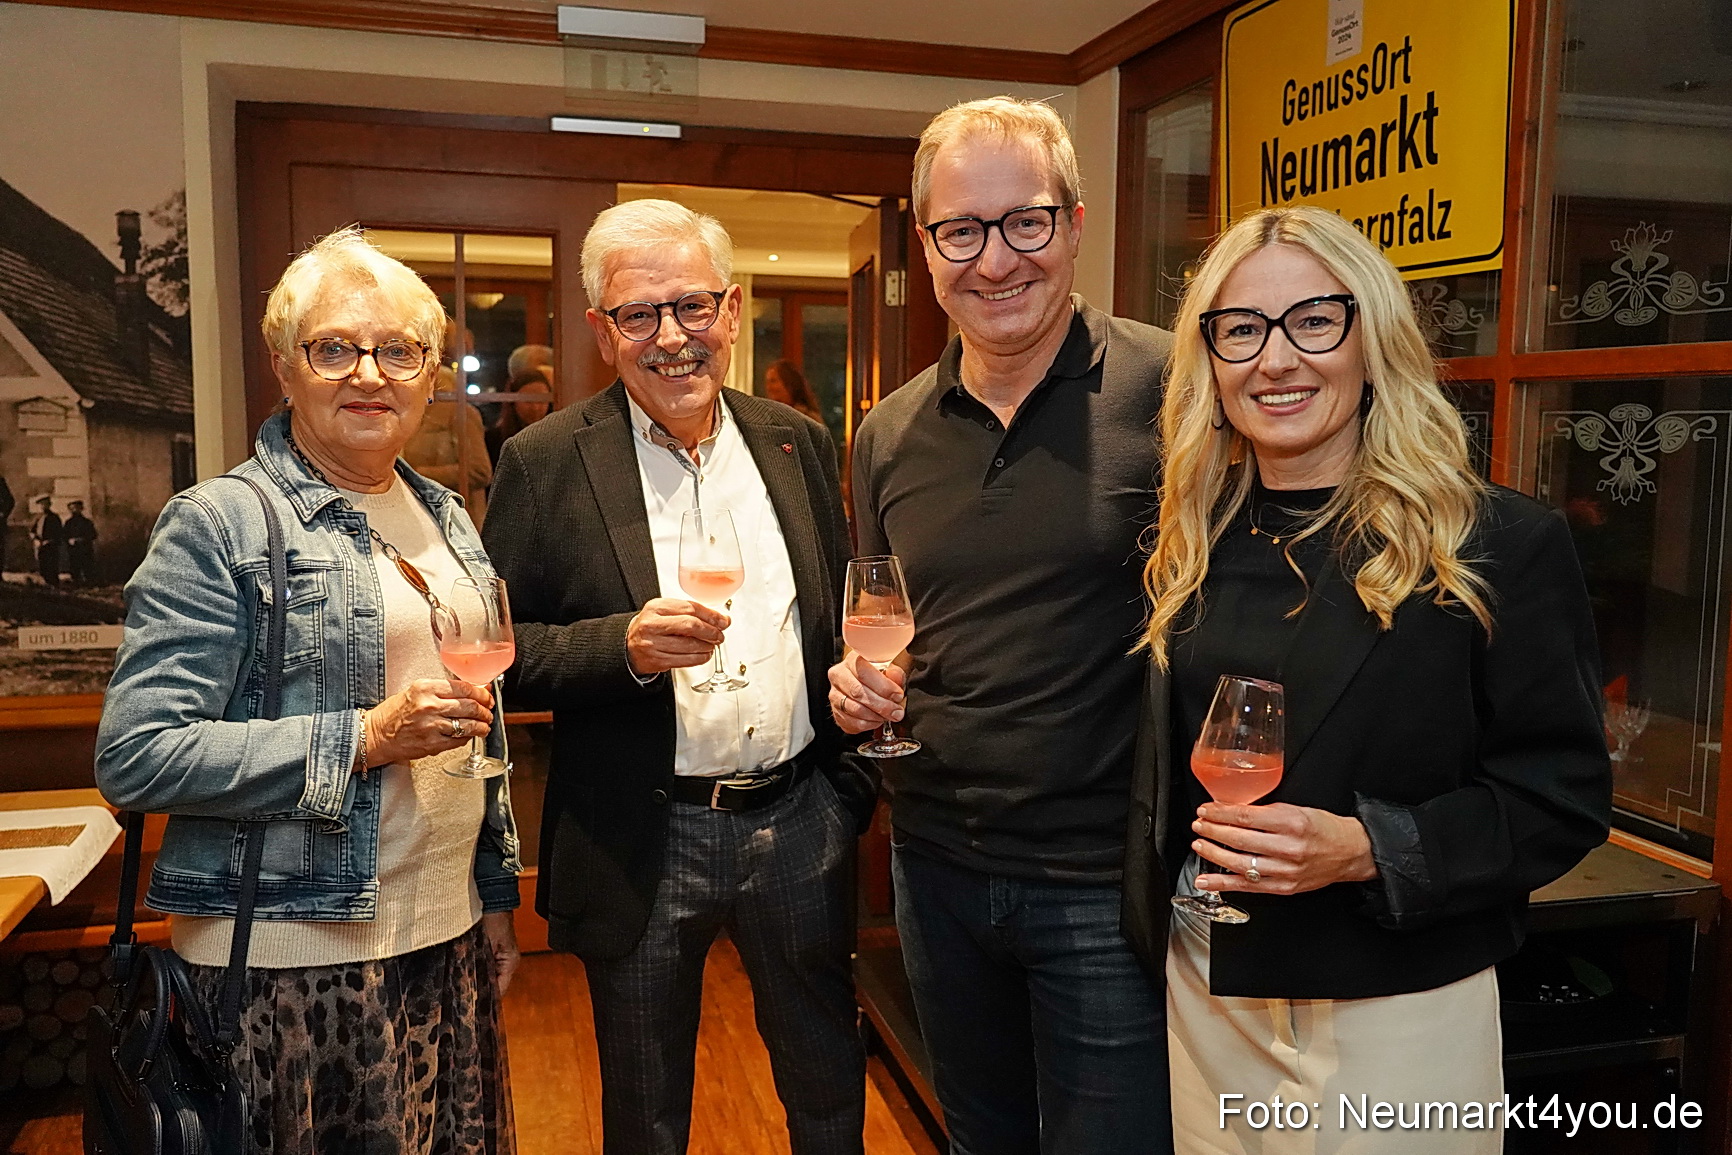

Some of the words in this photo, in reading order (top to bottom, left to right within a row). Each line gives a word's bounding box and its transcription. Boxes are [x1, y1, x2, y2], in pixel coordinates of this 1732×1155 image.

[1282, 35, 1413, 127] GenussOrt
[1261, 90, 1439, 208] Neumarkt
[29, 633, 54, 645] um
[60, 630, 98, 644] 1880
